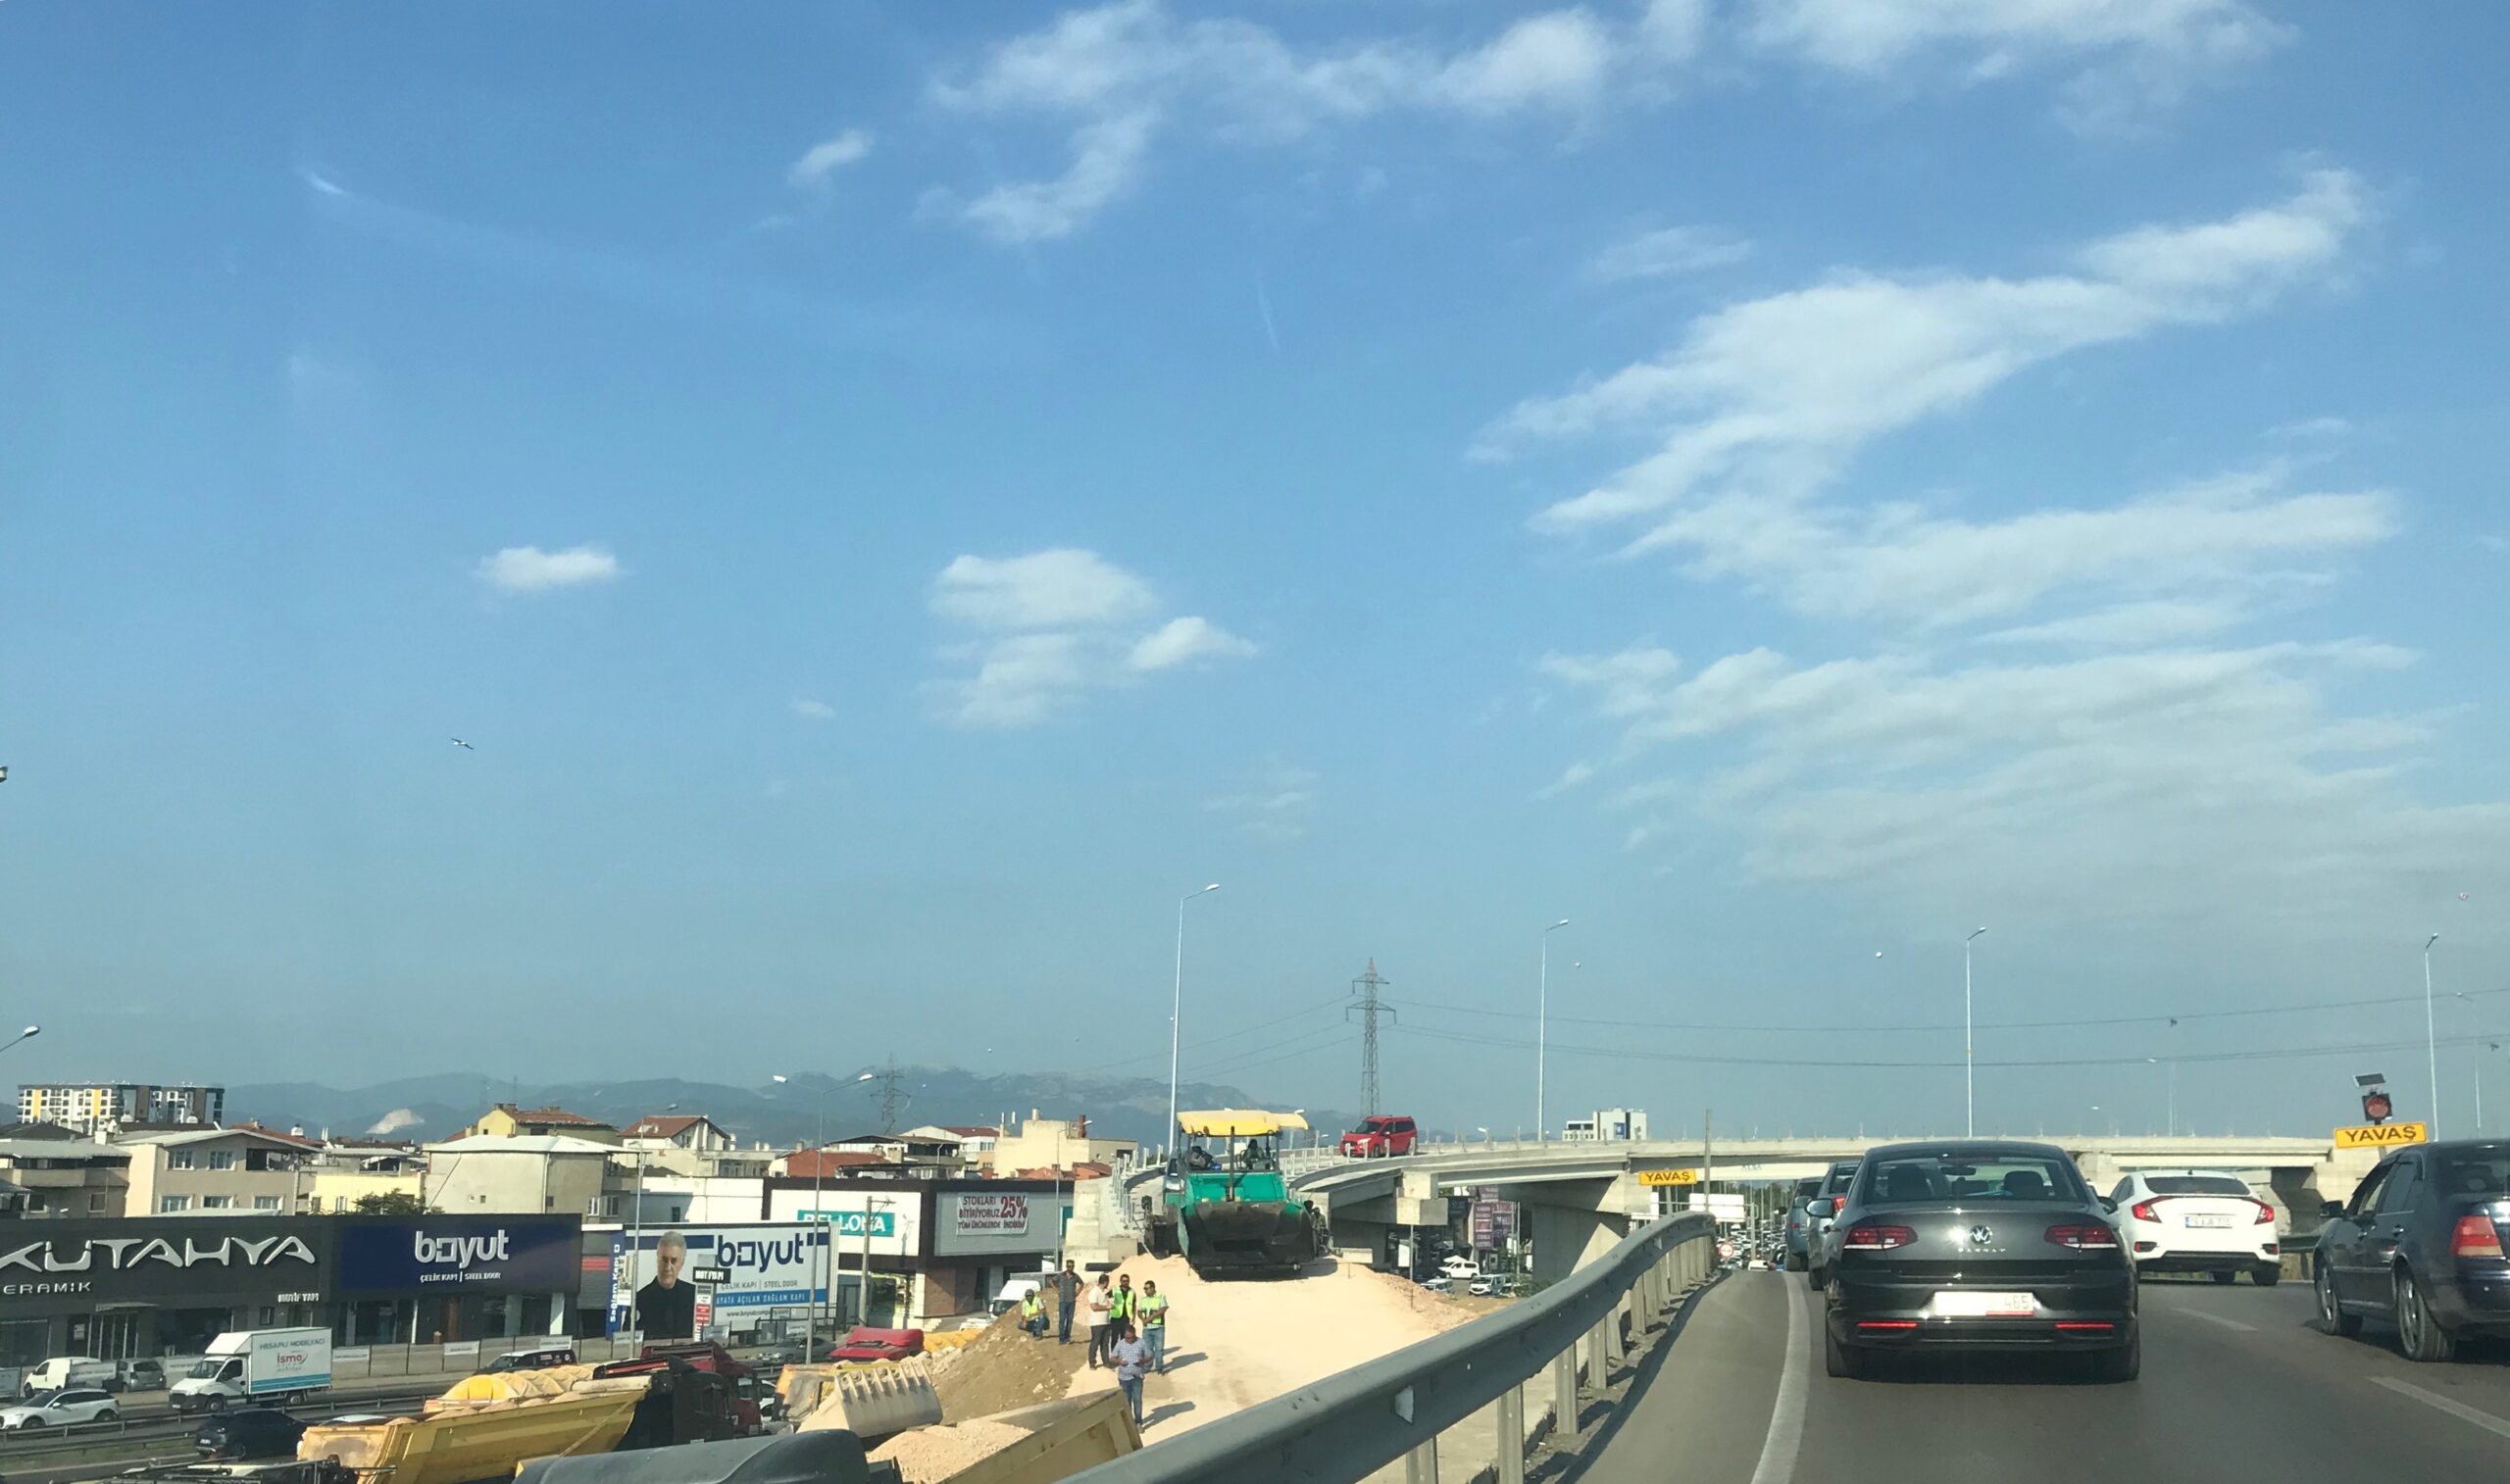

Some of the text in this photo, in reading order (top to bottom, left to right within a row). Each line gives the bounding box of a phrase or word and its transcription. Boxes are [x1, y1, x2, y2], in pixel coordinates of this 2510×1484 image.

[2345, 1125, 2417, 1143] YAVAŞ
[1645, 1171, 1690, 1182] YAVAŞ
[963, 1196, 996, 1206] STOKLARI
[1000, 1195, 1029, 1218] 25%
[741, 1280, 757, 1289] KAPI
[764, 1279, 798, 1289] STEEL DOOR
